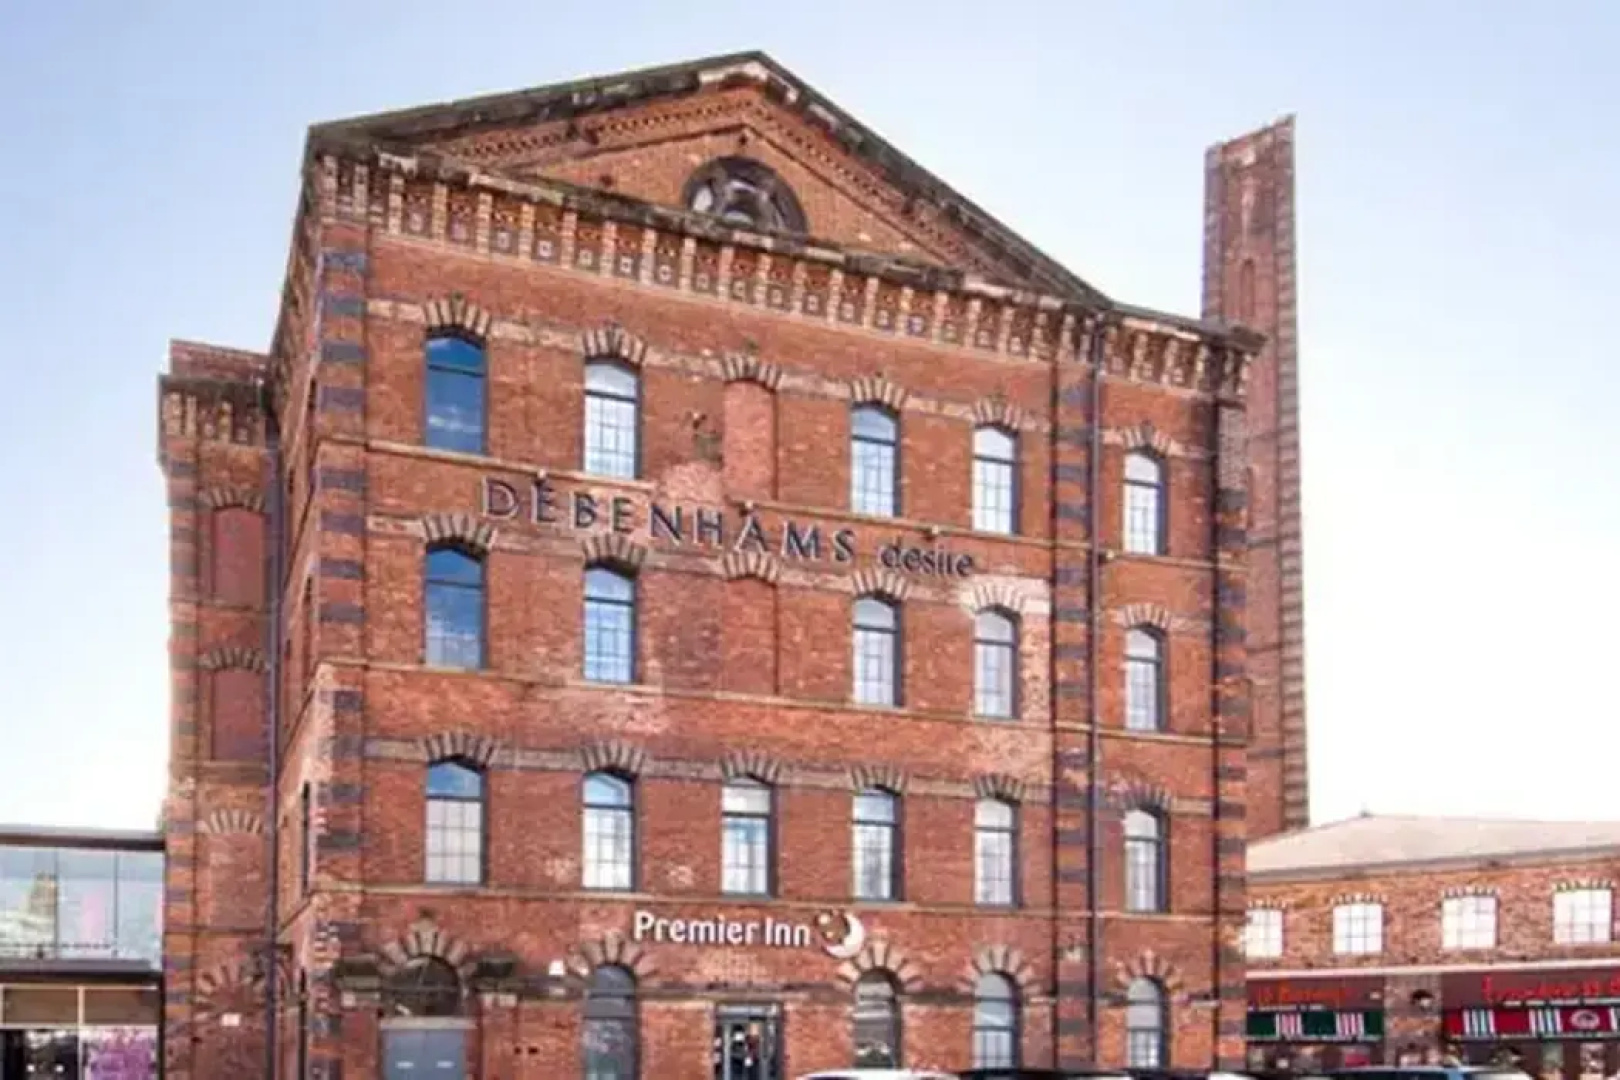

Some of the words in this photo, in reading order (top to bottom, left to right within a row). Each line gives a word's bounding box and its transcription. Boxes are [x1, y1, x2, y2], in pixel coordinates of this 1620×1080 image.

[481, 476, 857, 563] DEBENHAMS
[633, 910, 759, 945] Premier
[764, 916, 811, 947] Inn
